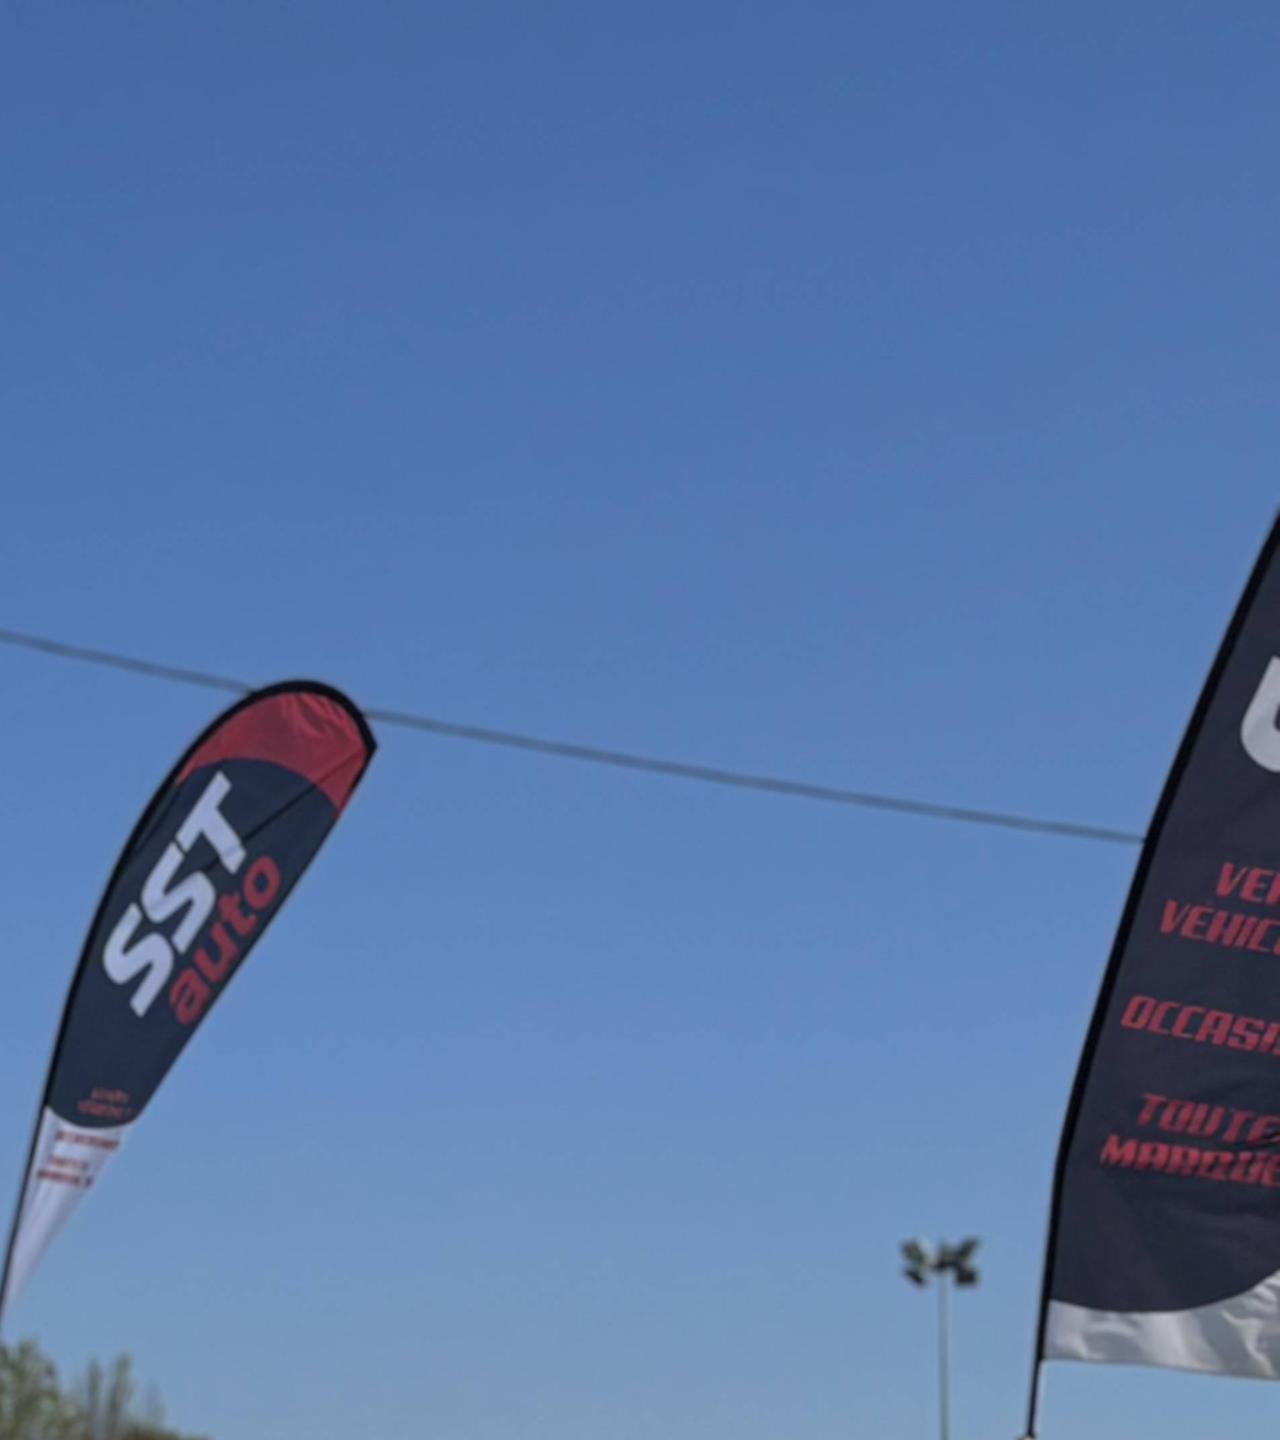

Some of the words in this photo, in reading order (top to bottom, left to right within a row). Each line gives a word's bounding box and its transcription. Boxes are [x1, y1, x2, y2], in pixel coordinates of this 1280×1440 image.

[103, 770, 247, 1017] SST
[169, 855, 281, 1024] auto
[1160, 898, 1280, 956] VEHIC
[1120, 994, 1280, 1057] OCCASI
